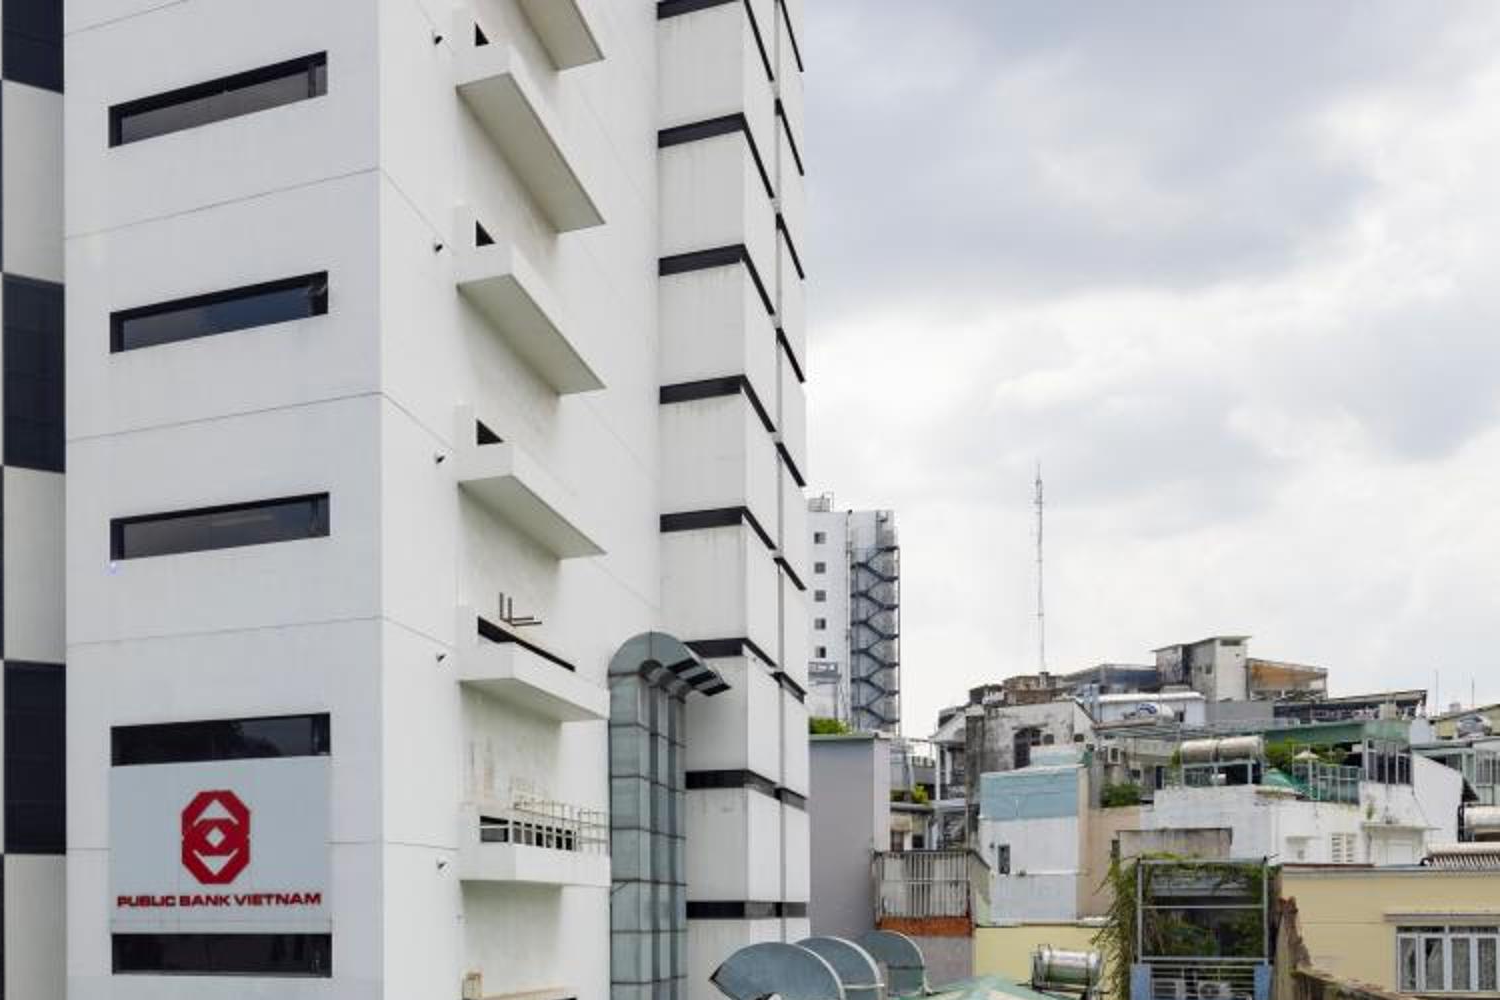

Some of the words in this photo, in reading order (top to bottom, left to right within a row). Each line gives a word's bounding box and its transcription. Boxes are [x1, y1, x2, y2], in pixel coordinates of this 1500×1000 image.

[117, 895, 176, 907] PUBLIC
[179, 894, 231, 906] BANK
[233, 893, 321, 906] VIETNAM
